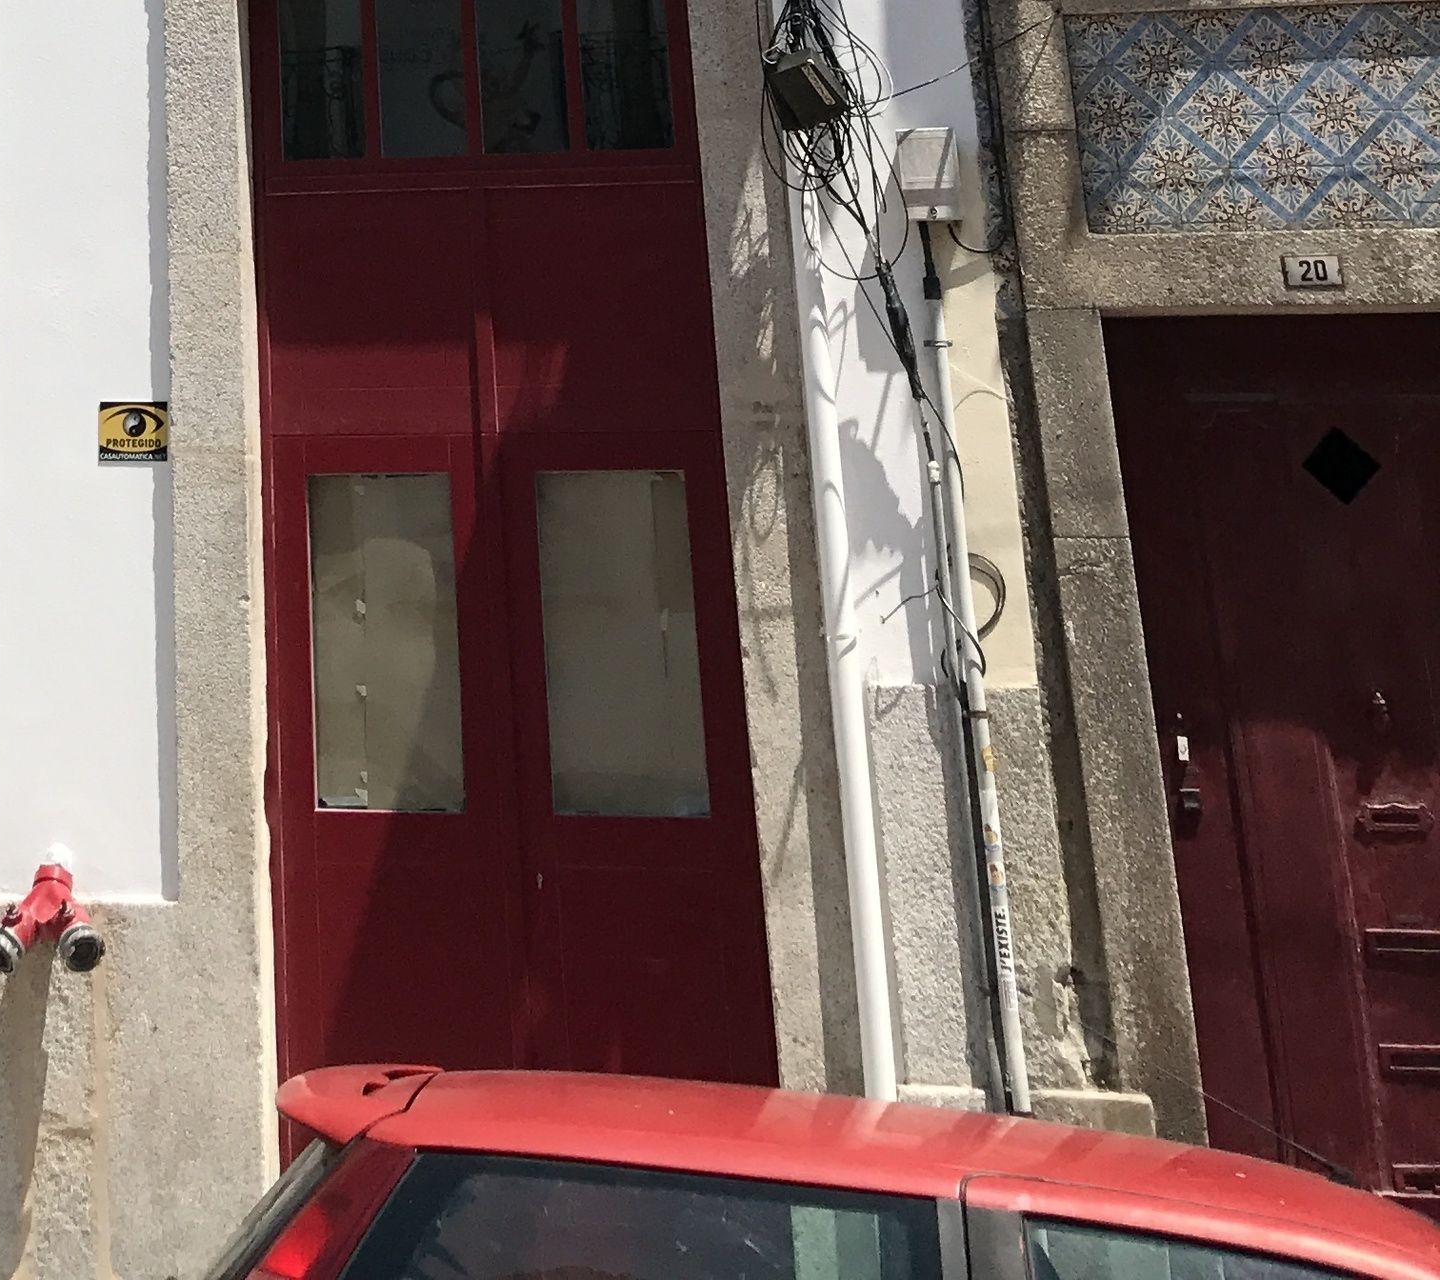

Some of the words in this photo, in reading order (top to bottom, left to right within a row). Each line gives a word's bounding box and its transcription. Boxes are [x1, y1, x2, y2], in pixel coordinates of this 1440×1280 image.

[1298, 260, 1328, 282] 20
[106, 438, 162, 448] PROTEGIDO
[994, 908, 1013, 973] J'EXISTE.
